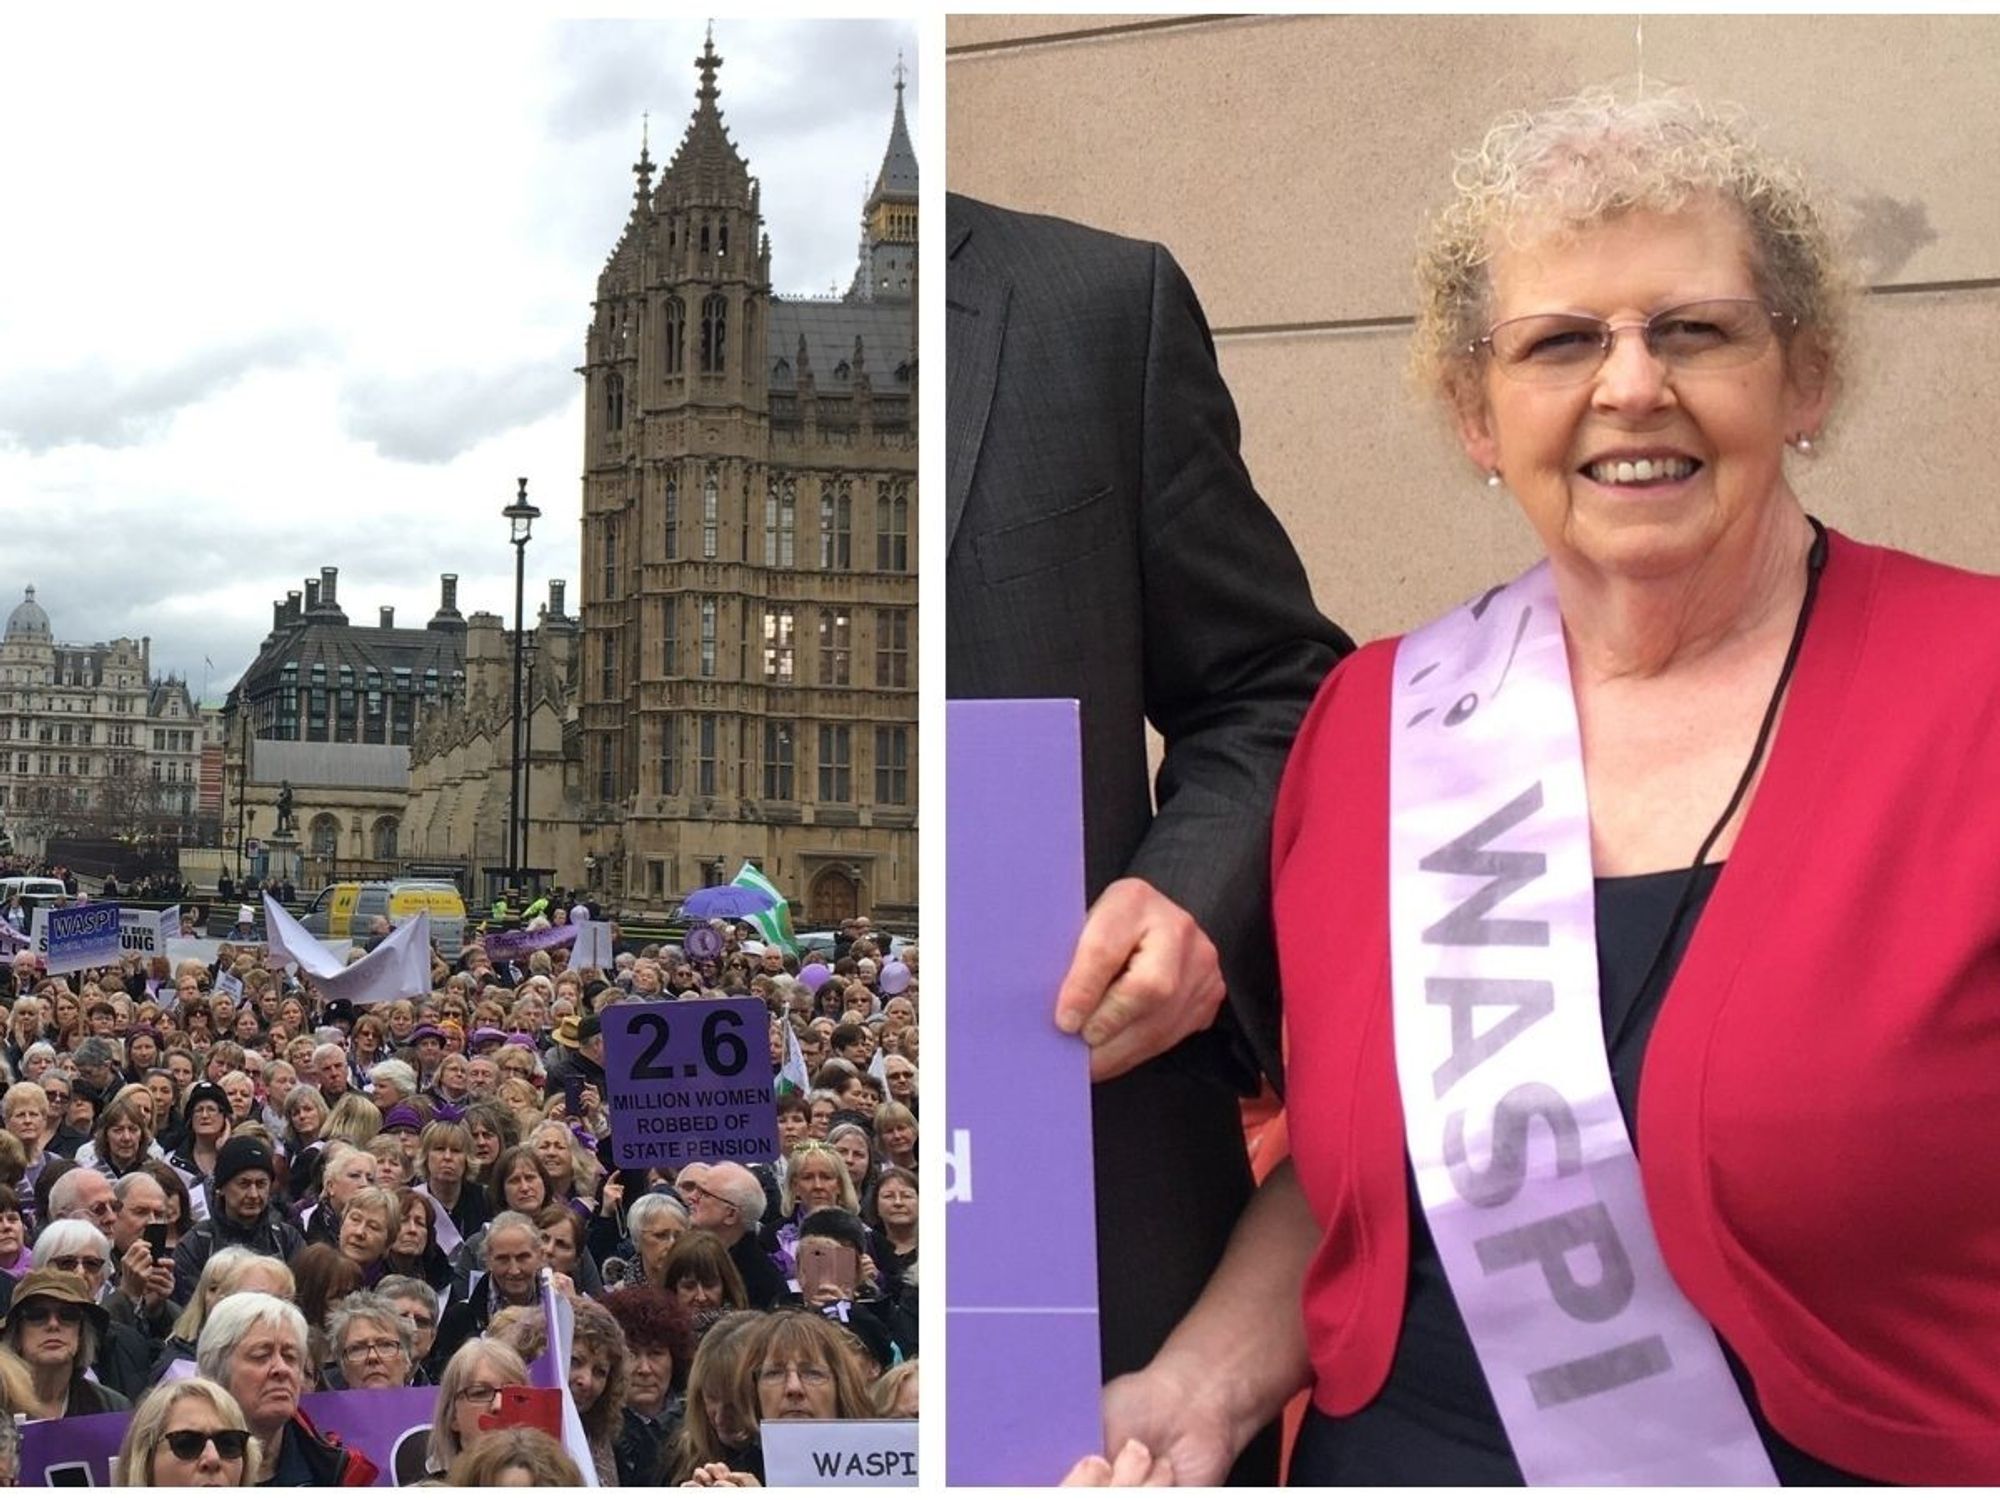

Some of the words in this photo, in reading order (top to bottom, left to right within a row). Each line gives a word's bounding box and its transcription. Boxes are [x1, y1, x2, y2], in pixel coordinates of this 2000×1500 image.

[54, 908, 118, 939] WASPI
[626, 1009, 748, 1080] 2.6
[613, 1093, 690, 1110] MILLION
[697, 1088, 770, 1106] WOMEN
[1419, 780, 1671, 1411] WASPI
[637, 1116, 718, 1134] ROBBED
[725, 1114, 750, 1129] OF
[622, 1142, 681, 1160] STATE
[688, 1138, 771, 1157] PENSION
[811, 1452, 917, 1478] WASPI
